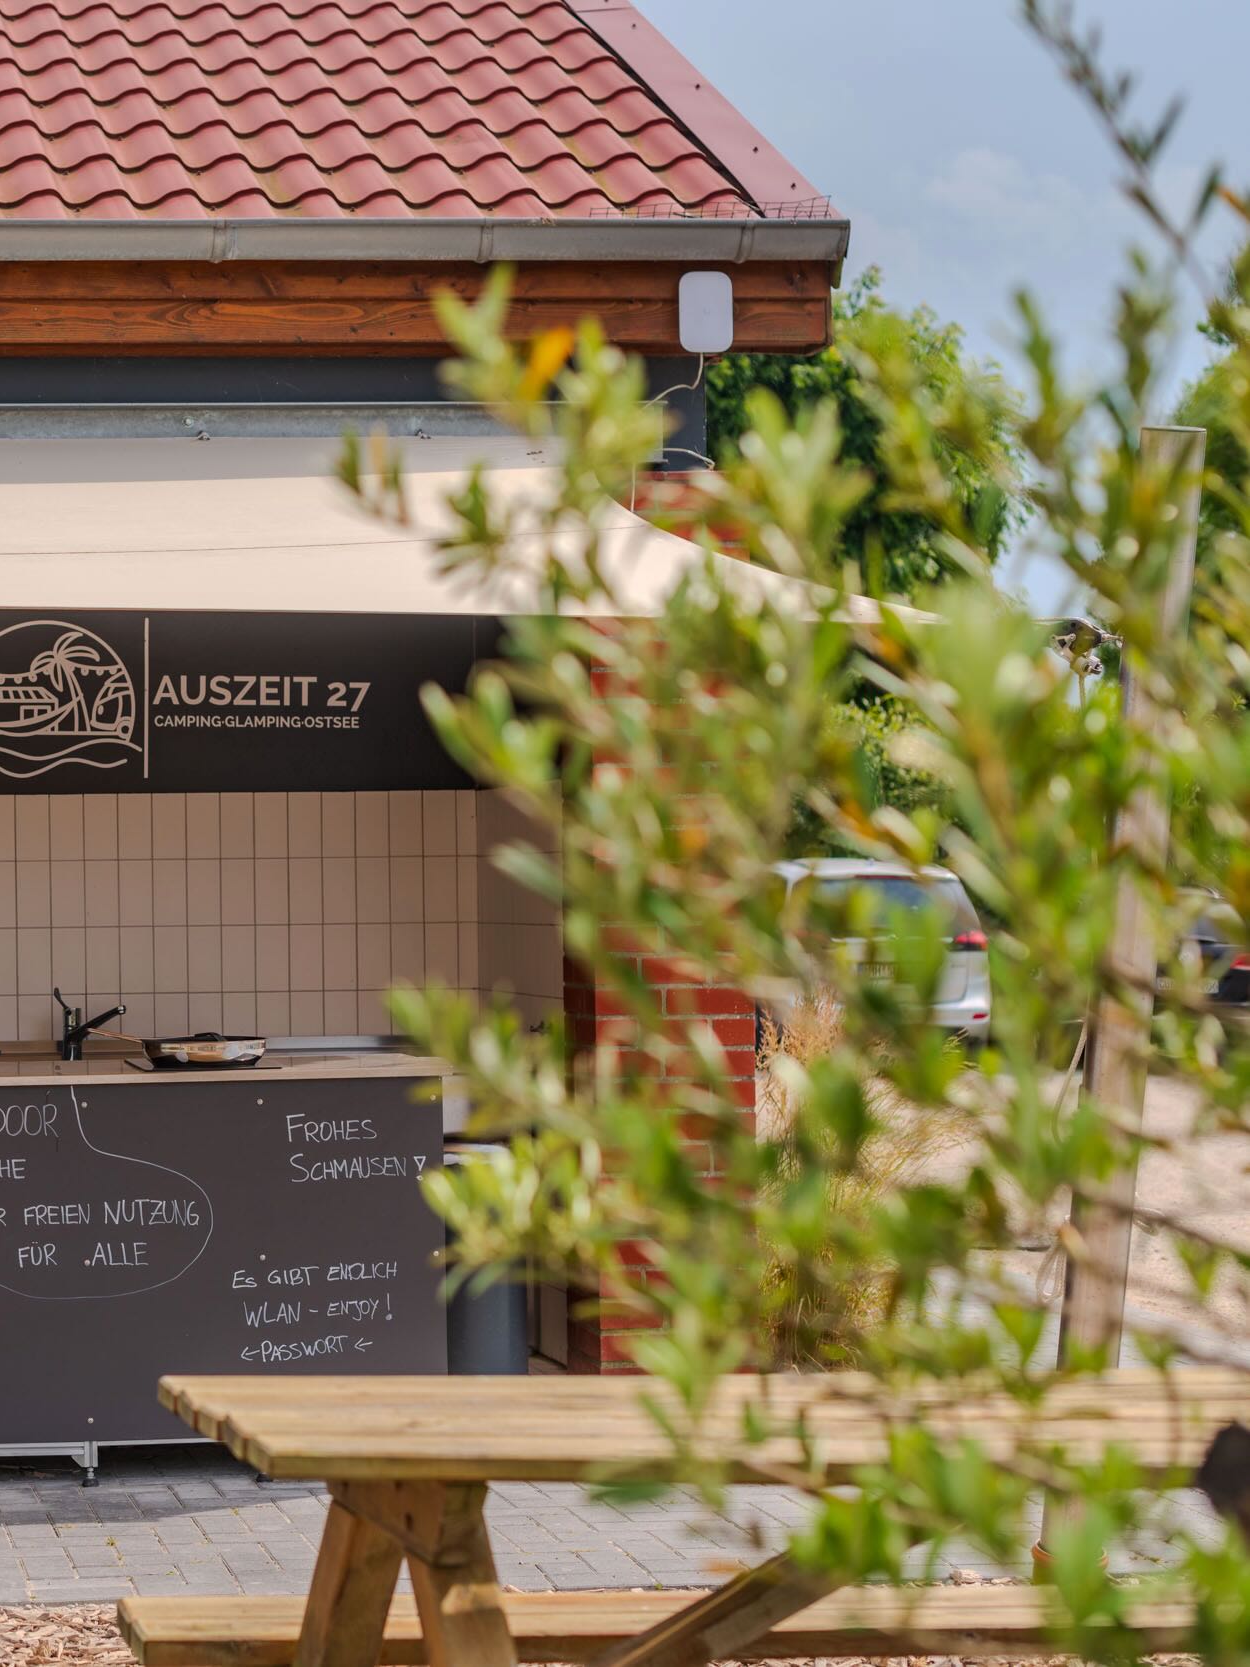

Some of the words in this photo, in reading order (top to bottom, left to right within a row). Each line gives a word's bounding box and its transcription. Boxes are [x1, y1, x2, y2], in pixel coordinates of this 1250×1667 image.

[153, 675, 318, 706] AUSZEIT
[327, 682, 371, 712] 27
[286, 1114, 377, 1143] FROHES
[24, 1203, 90, 1225] FREIEN
[104, 1199, 200, 1226] NUTZUNG
[18, 1242, 58, 1268] FÜR
[92, 1242, 149, 1266] ALLE
[267, 1266, 319, 1286] GIBT
[326, 1261, 398, 1282] ENDLICH
[243, 1301, 301, 1328] WLAN
[261, 1335, 348, 1363] PASSWORT
